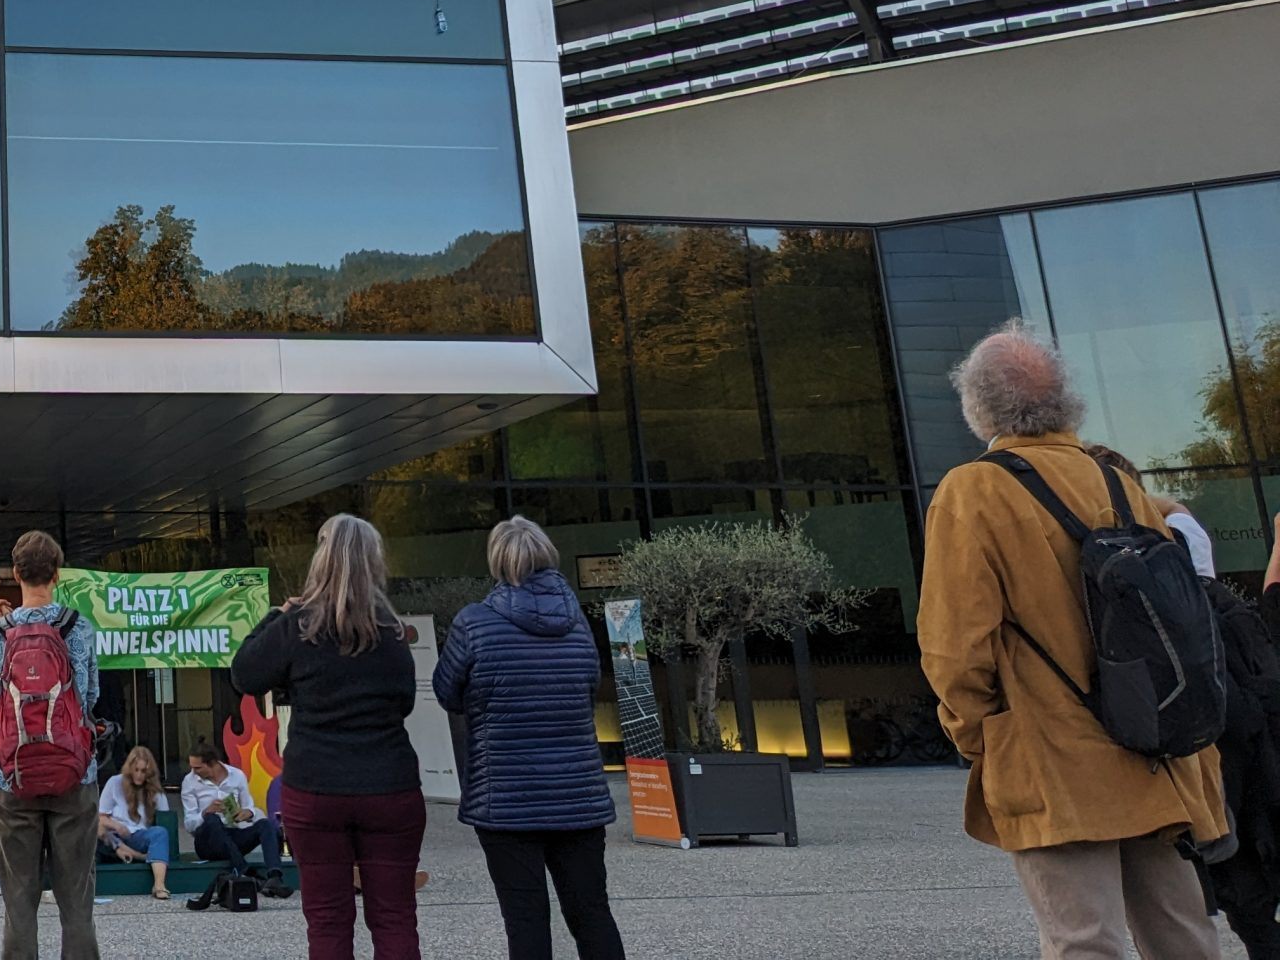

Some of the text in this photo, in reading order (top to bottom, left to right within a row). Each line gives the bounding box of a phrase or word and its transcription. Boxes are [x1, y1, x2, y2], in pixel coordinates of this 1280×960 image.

[108, 586, 190, 612] PLATZ 1
[130, 613, 169, 626] FÜR DIE
[96, 628, 230, 656] NNELSPINNE
